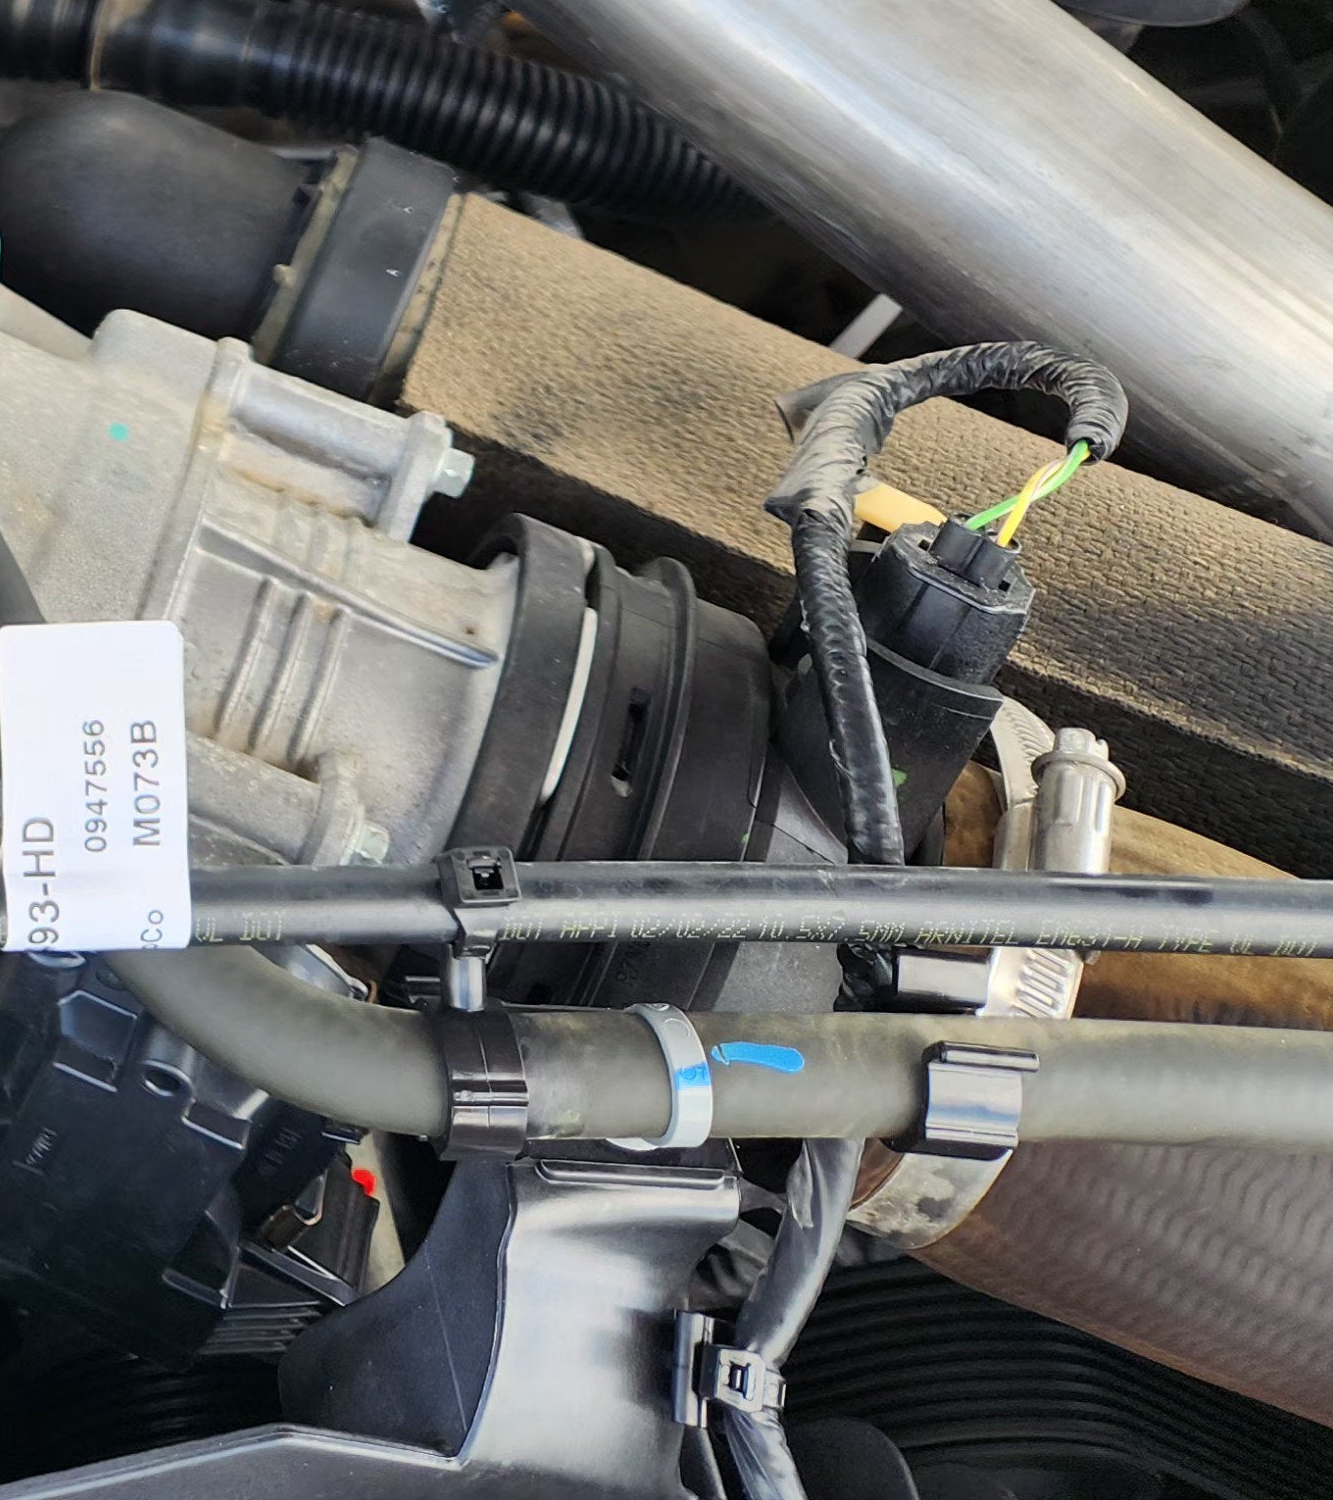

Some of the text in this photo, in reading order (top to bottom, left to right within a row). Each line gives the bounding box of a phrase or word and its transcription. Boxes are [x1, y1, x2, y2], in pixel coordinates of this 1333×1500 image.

[82, 719, 108, 853] 0947556
[130, 720, 161, 847] M073B
[22, 816, 60, 951] 93-HD
[630, 912, 751, 940] 02/02/22
[914, 919, 1020, 946] ARNITEL
[1158, 923, 1221, 954] TYPE
